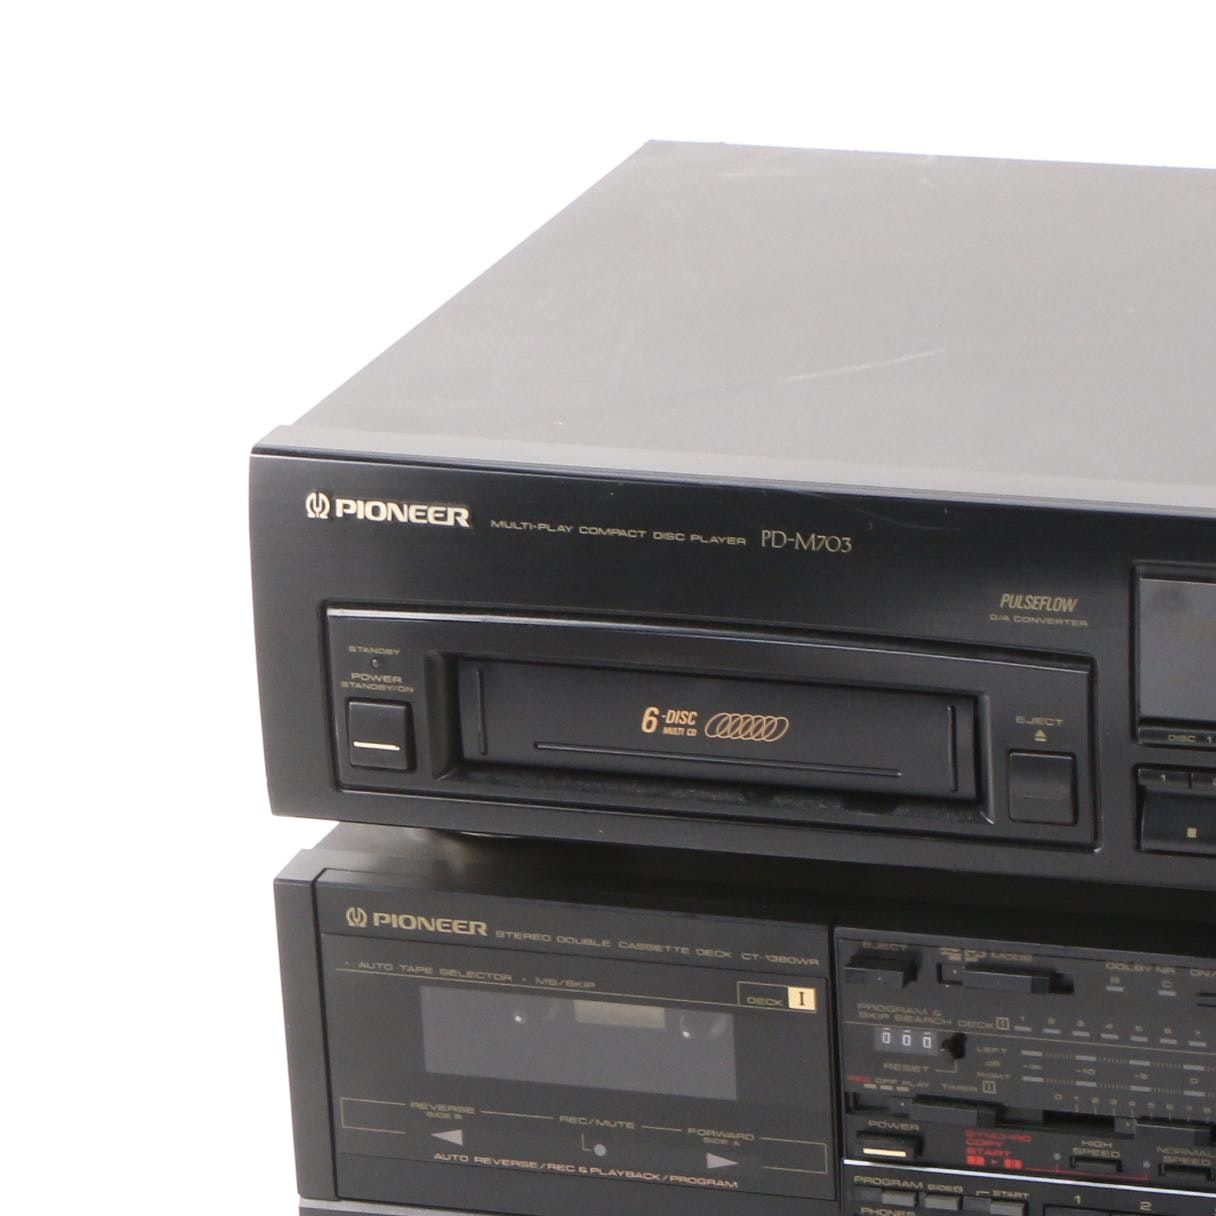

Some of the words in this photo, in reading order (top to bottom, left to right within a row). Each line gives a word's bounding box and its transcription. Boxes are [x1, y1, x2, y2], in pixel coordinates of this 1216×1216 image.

[335, 498, 470, 527] PIONEER
[491, 519, 572, 533] MULTI-PLAY
[579, 526, 646, 538] COMPACT
[653, 531, 686, 542] DISC
[691, 534, 746, 546] PLAYER
[761, 530, 853, 553] PD-M703
[1000, 594, 1078, 612] PULSEFLOW
[989, 613, 1009, 623] D/A
[1014, 614, 1088, 627] CONVERTER
[348, 645, 401, 656] STANDBY
[351, 672, 403, 684] POWER
[340, 681, 414, 693] STANDBY/ON
[641, 707, 698, 733] 6-DISC
[1015, 716, 1064, 728] EJECT
[1168, 734, 1196, 744] DISC
[1206, 736, 1213, 744] 1
[373, 912, 489, 937] PIONEER
[495, 930, 552, 943] STEREO
[556, 936, 612, 948] DOUBLE
[618, 941, 691, 955] CASSETTE
[695, 948, 732, 959] DECK
[358, 961, 393, 971] AUTO
[399, 964, 434, 975] TAPE
[439, 968, 513, 982] SELECTOR
[1105, 962, 1152, 973] DOLBY
[1156, 966, 1176, 975] NR
[746, 996, 785, 1007] DECK
[410, 1101, 475, 1114] REVERSE
[559, 1115, 635, 1130] REC/MUTE
[868, 1120, 920, 1132] POWER
[687, 1127, 755, 1141] FORWARD
[434, 1152, 468, 1163] AUTO
[474, 1156, 576, 1173] REVERSE/REC
[590, 1167, 738, 1188] PLAYBACK/PROGRAM
[853, 1175, 924, 1190] PROGRAM
[992, 1190, 1030, 1199] START
[1140, 1201, 1152, 1211] 2
